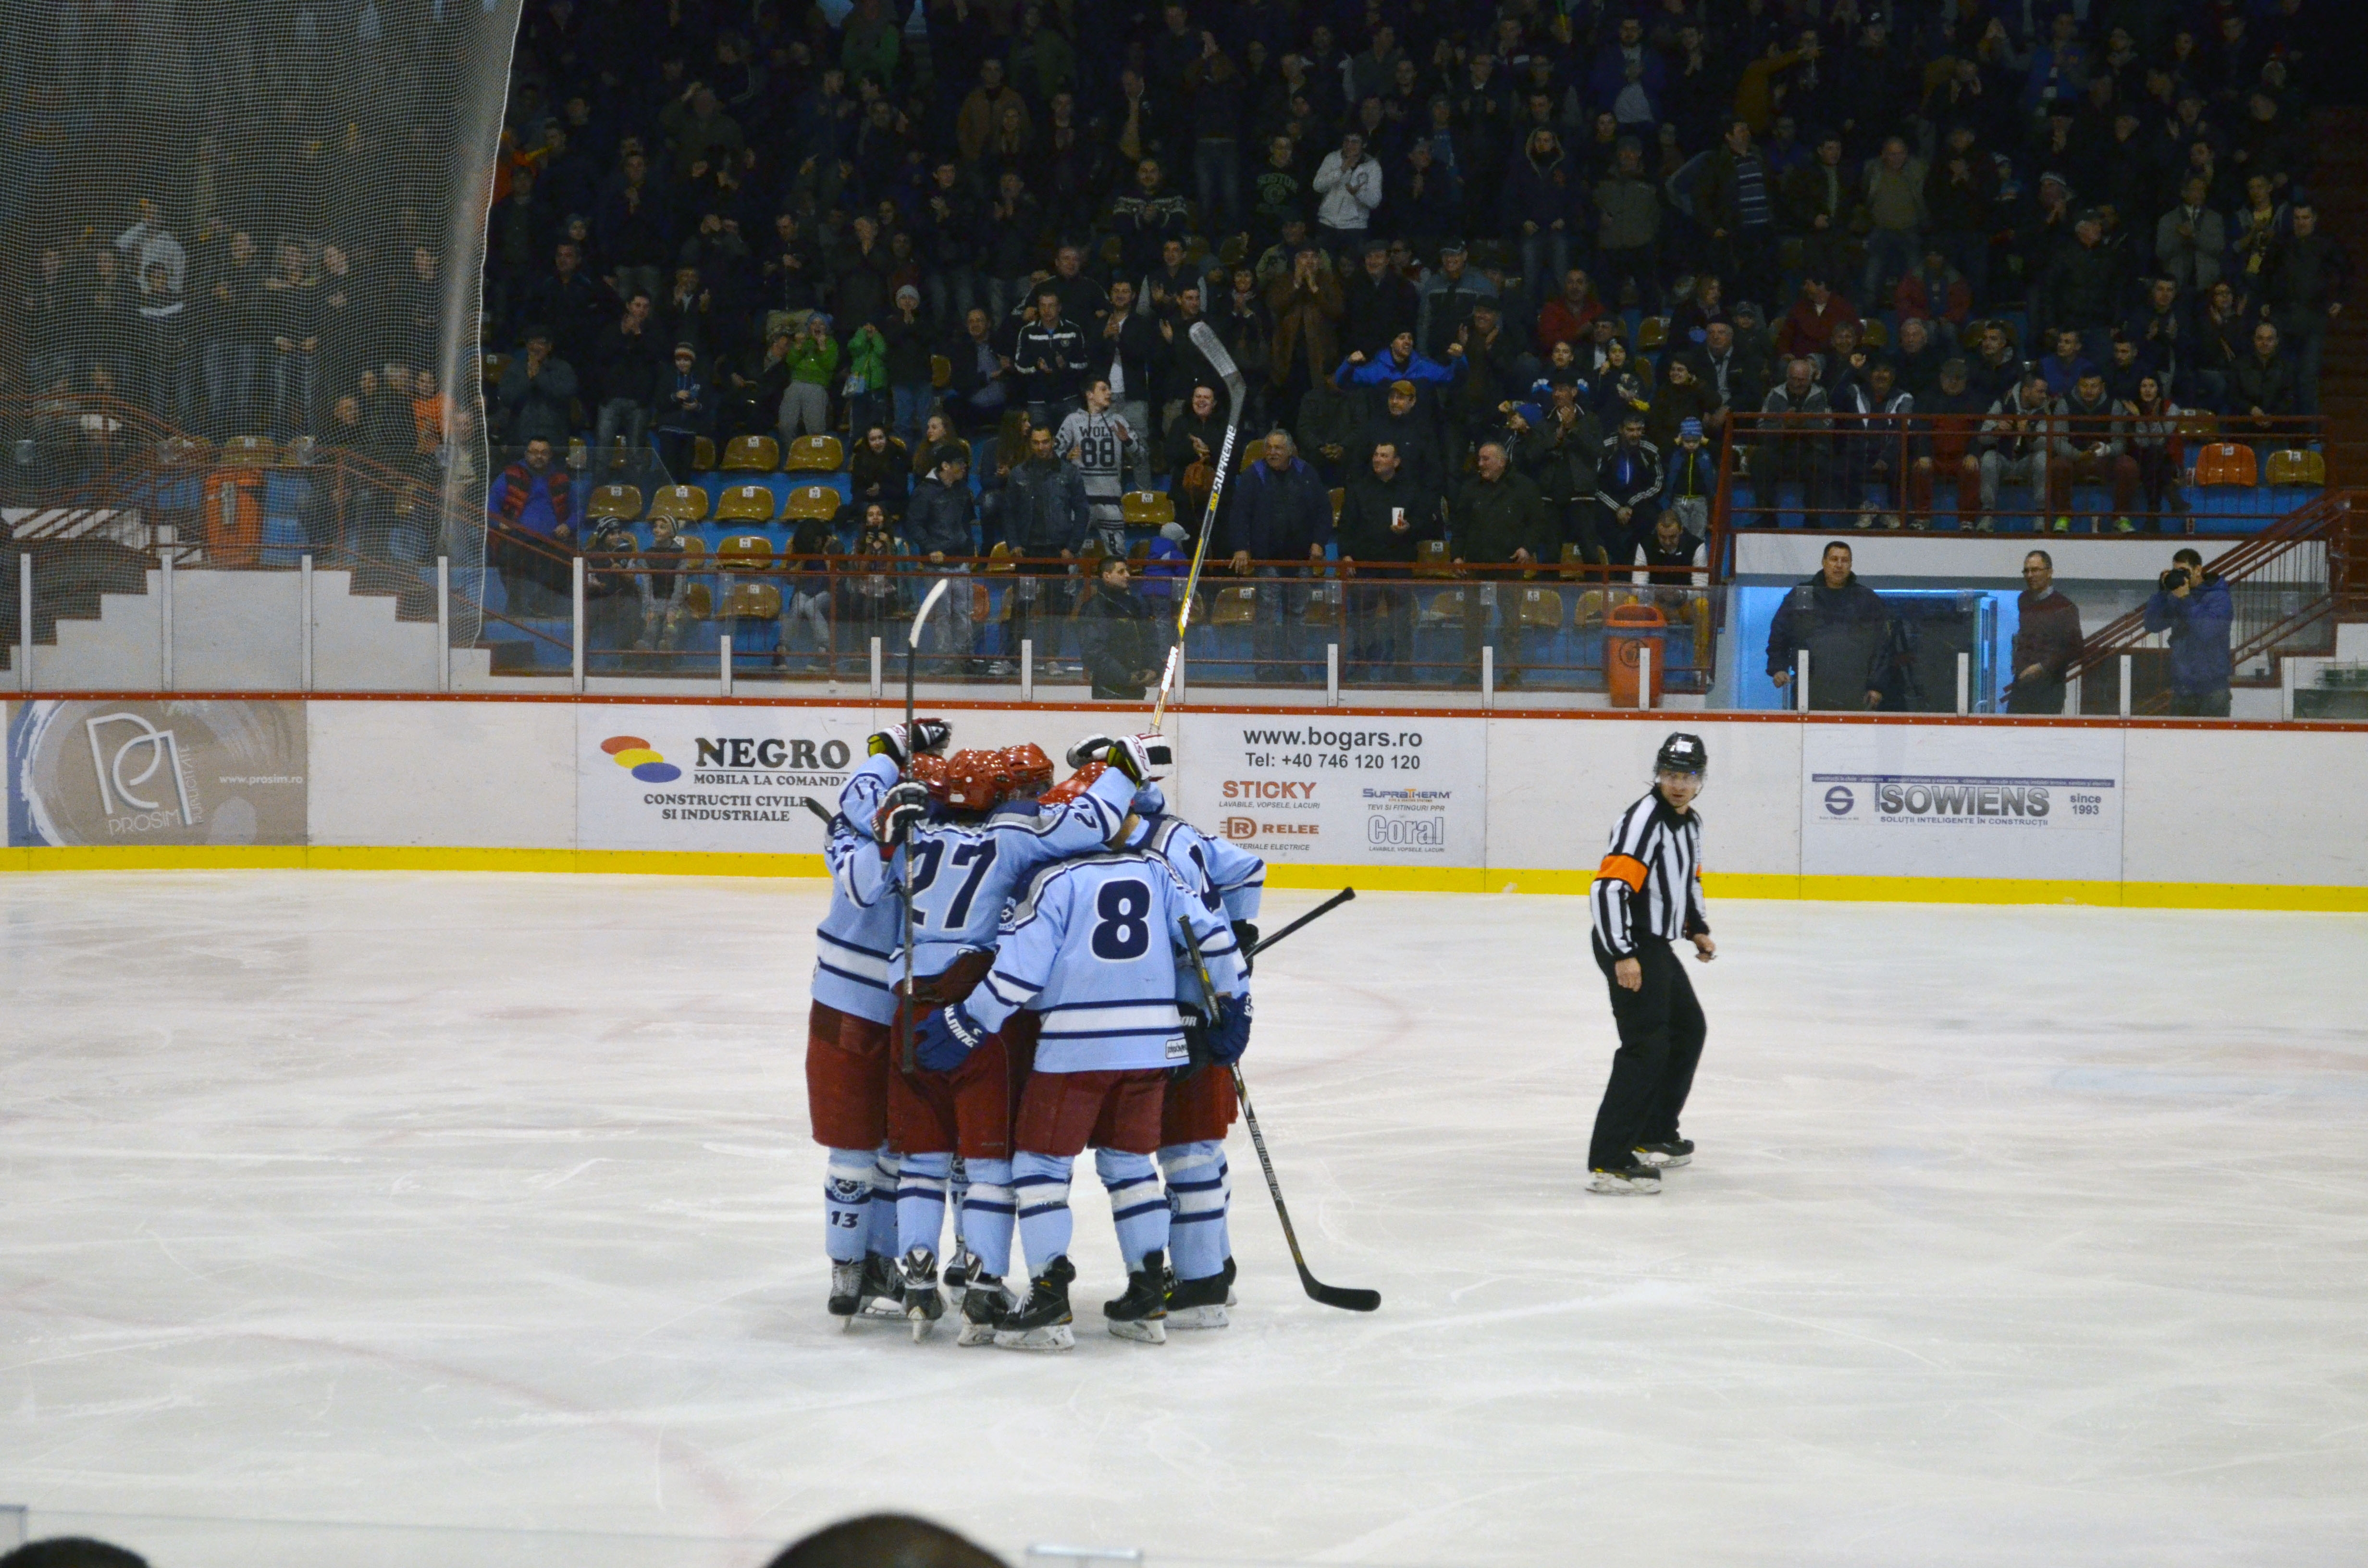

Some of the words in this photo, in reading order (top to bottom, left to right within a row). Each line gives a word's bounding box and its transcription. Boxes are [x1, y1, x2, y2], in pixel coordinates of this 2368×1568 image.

[1079, 426, 1113, 437] WOL
[1081, 438, 1114, 467] 88
[1213, 425, 1237, 492] SUPREME
[1244, 727, 1422, 750] www.bogars.ro
[694, 738, 851, 769] NEGRO
[1246, 752, 1275, 767] Tel:
[1282, 753, 1312, 768] +40
[1319, 754, 1348, 768] 746
[1356, 755, 1384, 769] 120
[1391, 755, 1420, 769] 120
[219, 773, 304, 786] www.prosim.ro
[694, 774, 749, 785] MOBILA
[754, 774, 772, 785] LA
[1222, 780, 1317, 799] STICKY
[644, 794, 751, 807] CONSTRUCTII
[755, 796, 808, 808] CIVILE
[1880, 784, 2050, 817] SOWIENS
[2070, 793, 2101, 803] since
[662, 809, 678, 820] SI
[681, 809, 789, 821] INDUSTRIALE
[2072, 805, 2099, 815] 1993
[109, 809, 182, 836] PROSIM
[1262, 824, 1319, 834] RELEE
[1368, 815, 1443, 845] Coral
[905, 835, 999, 931] 27
[1089, 877, 1152, 962] 8
[944, 1004, 978, 1048] ALMING
[1249, 1117, 1282, 1201] BAUER
[831, 1211, 859, 1228] 13
